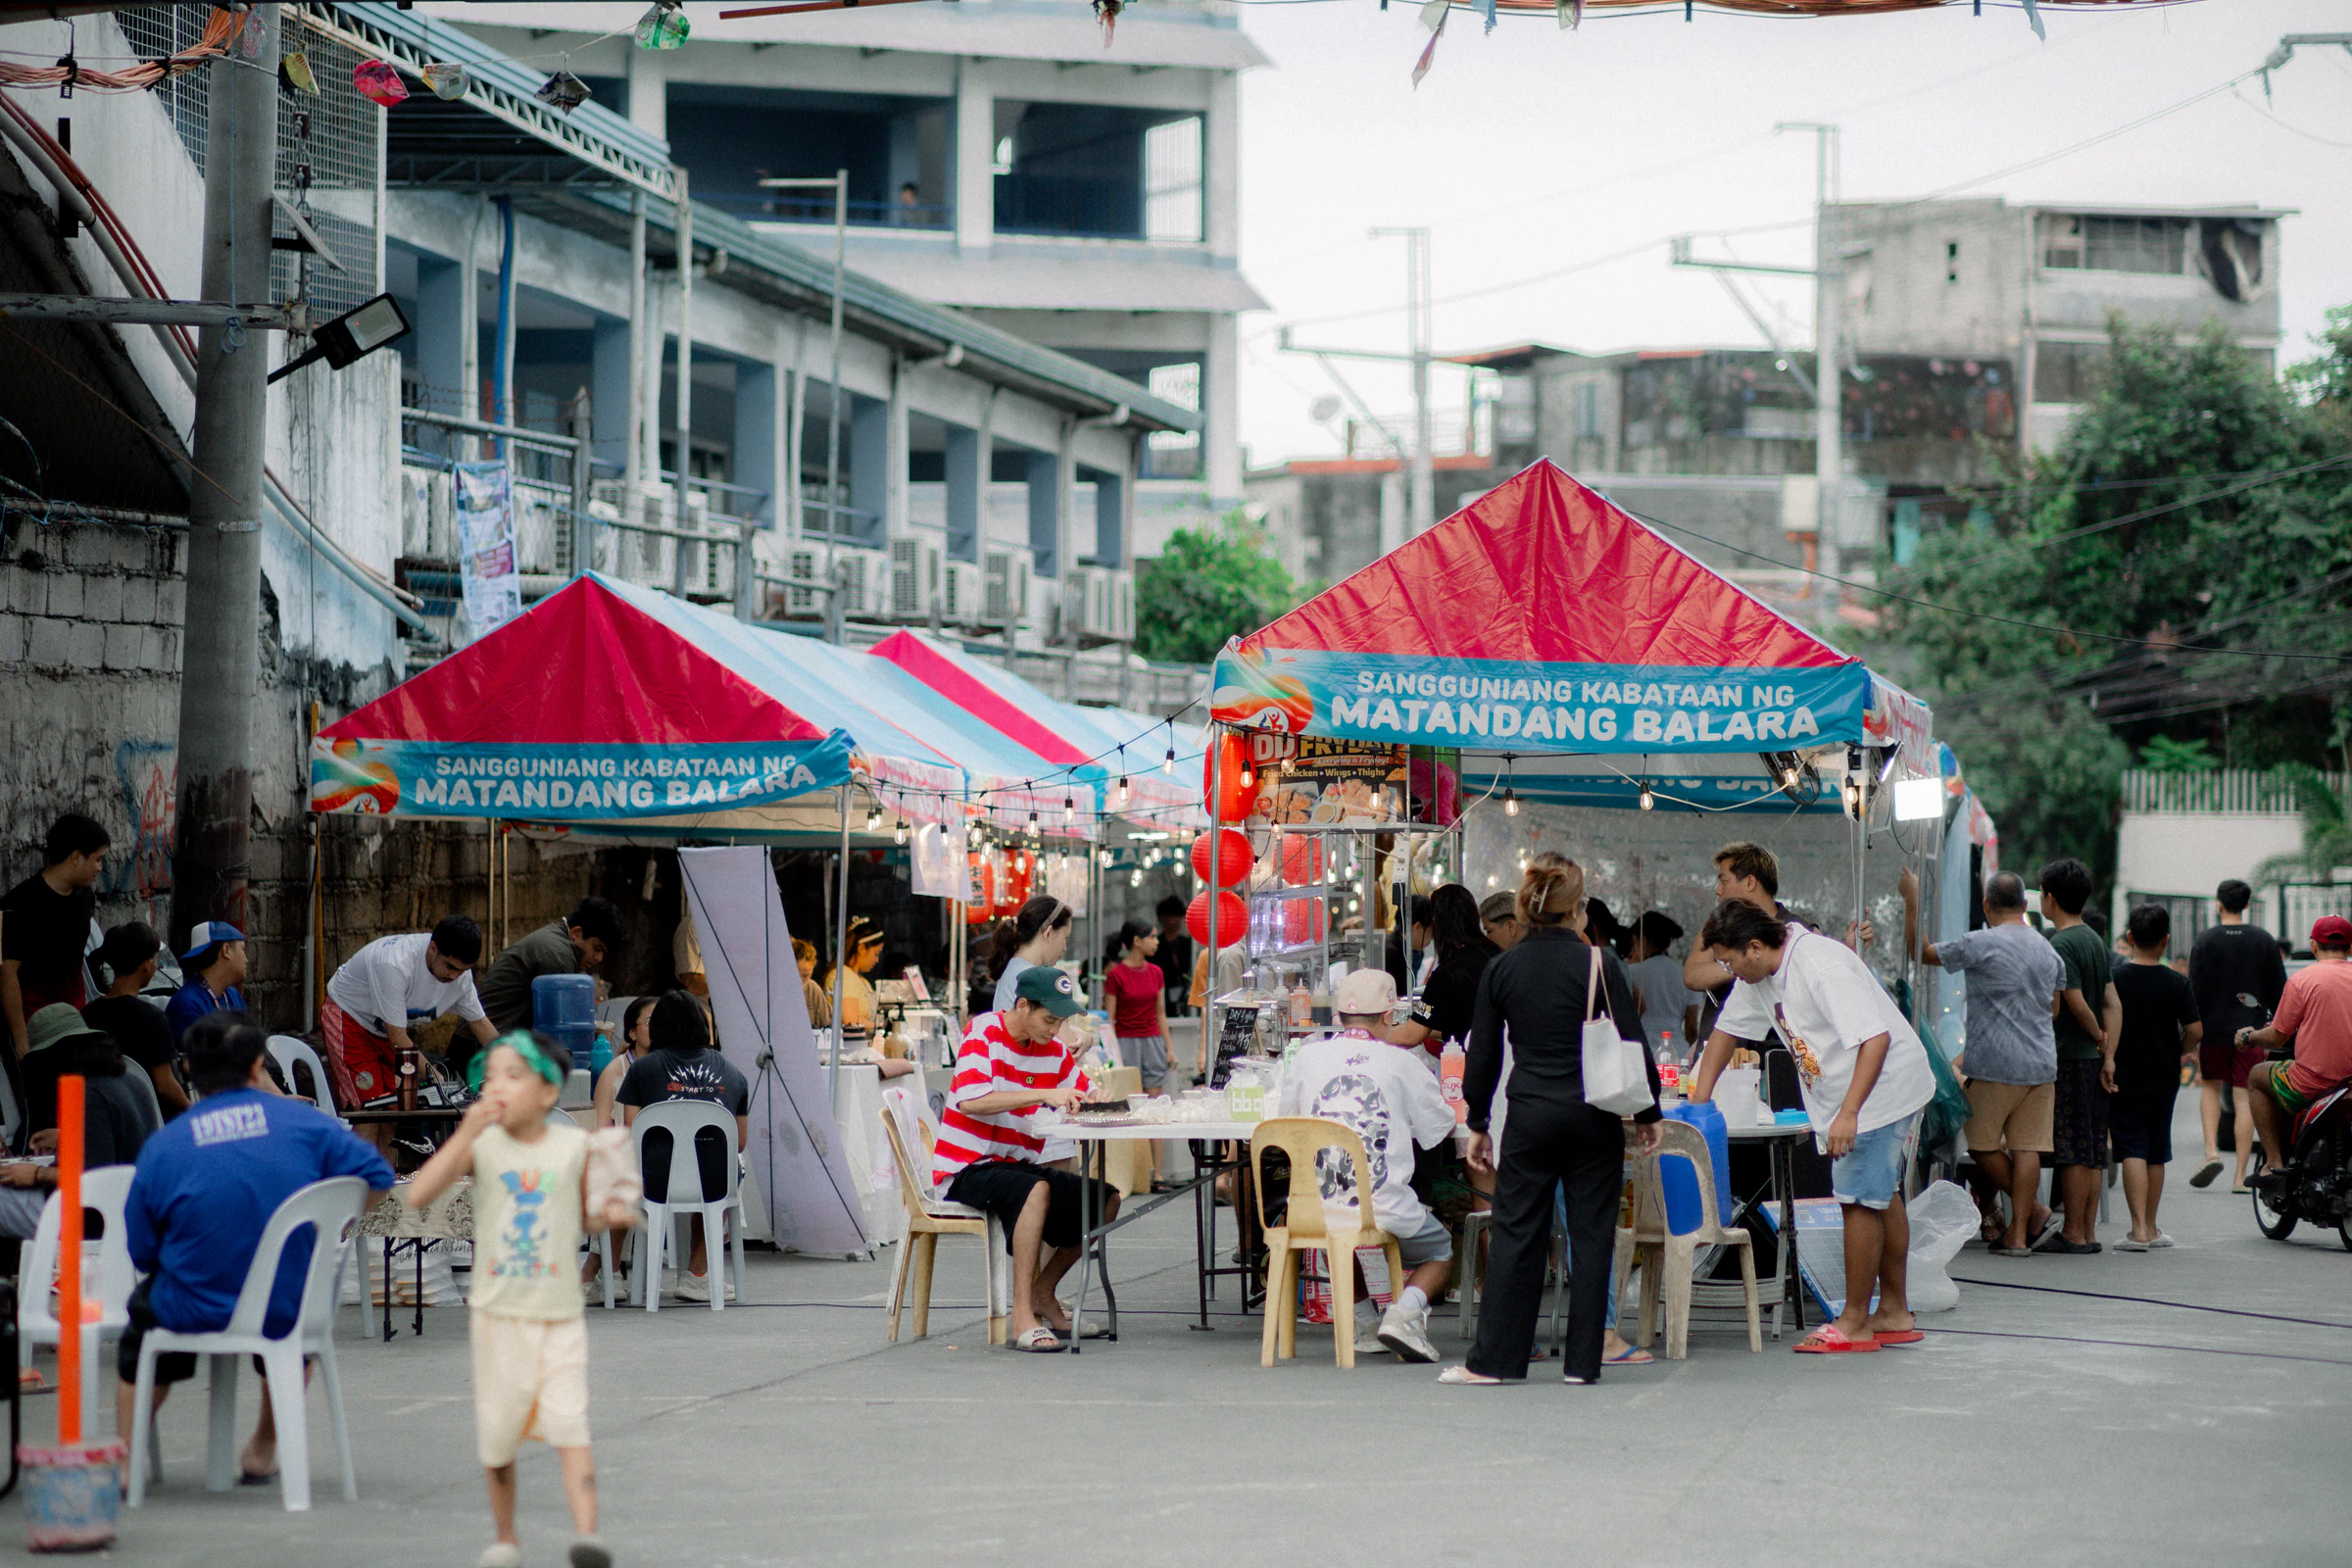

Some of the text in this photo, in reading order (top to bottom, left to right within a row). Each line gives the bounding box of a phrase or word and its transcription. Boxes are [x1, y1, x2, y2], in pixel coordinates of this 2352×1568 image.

[1356, 671, 1794, 708] SANGGUNIANG KABATAAN NG
[1331, 696, 1820, 742] MATANDANG BALARA
[1299, 735, 1395, 758] FRYDAY
[436, 755, 797, 777] SANGGUNIANG KABATAAN NG
[1262, 768, 1284, 778] Fried
[1324, 768, 1351, 778] Wings
[1357, 767, 1386, 778] Thighs
[1317, 757, 1351, 765] Everyday
[414, 763, 817, 808] MATANDANG BALARA
